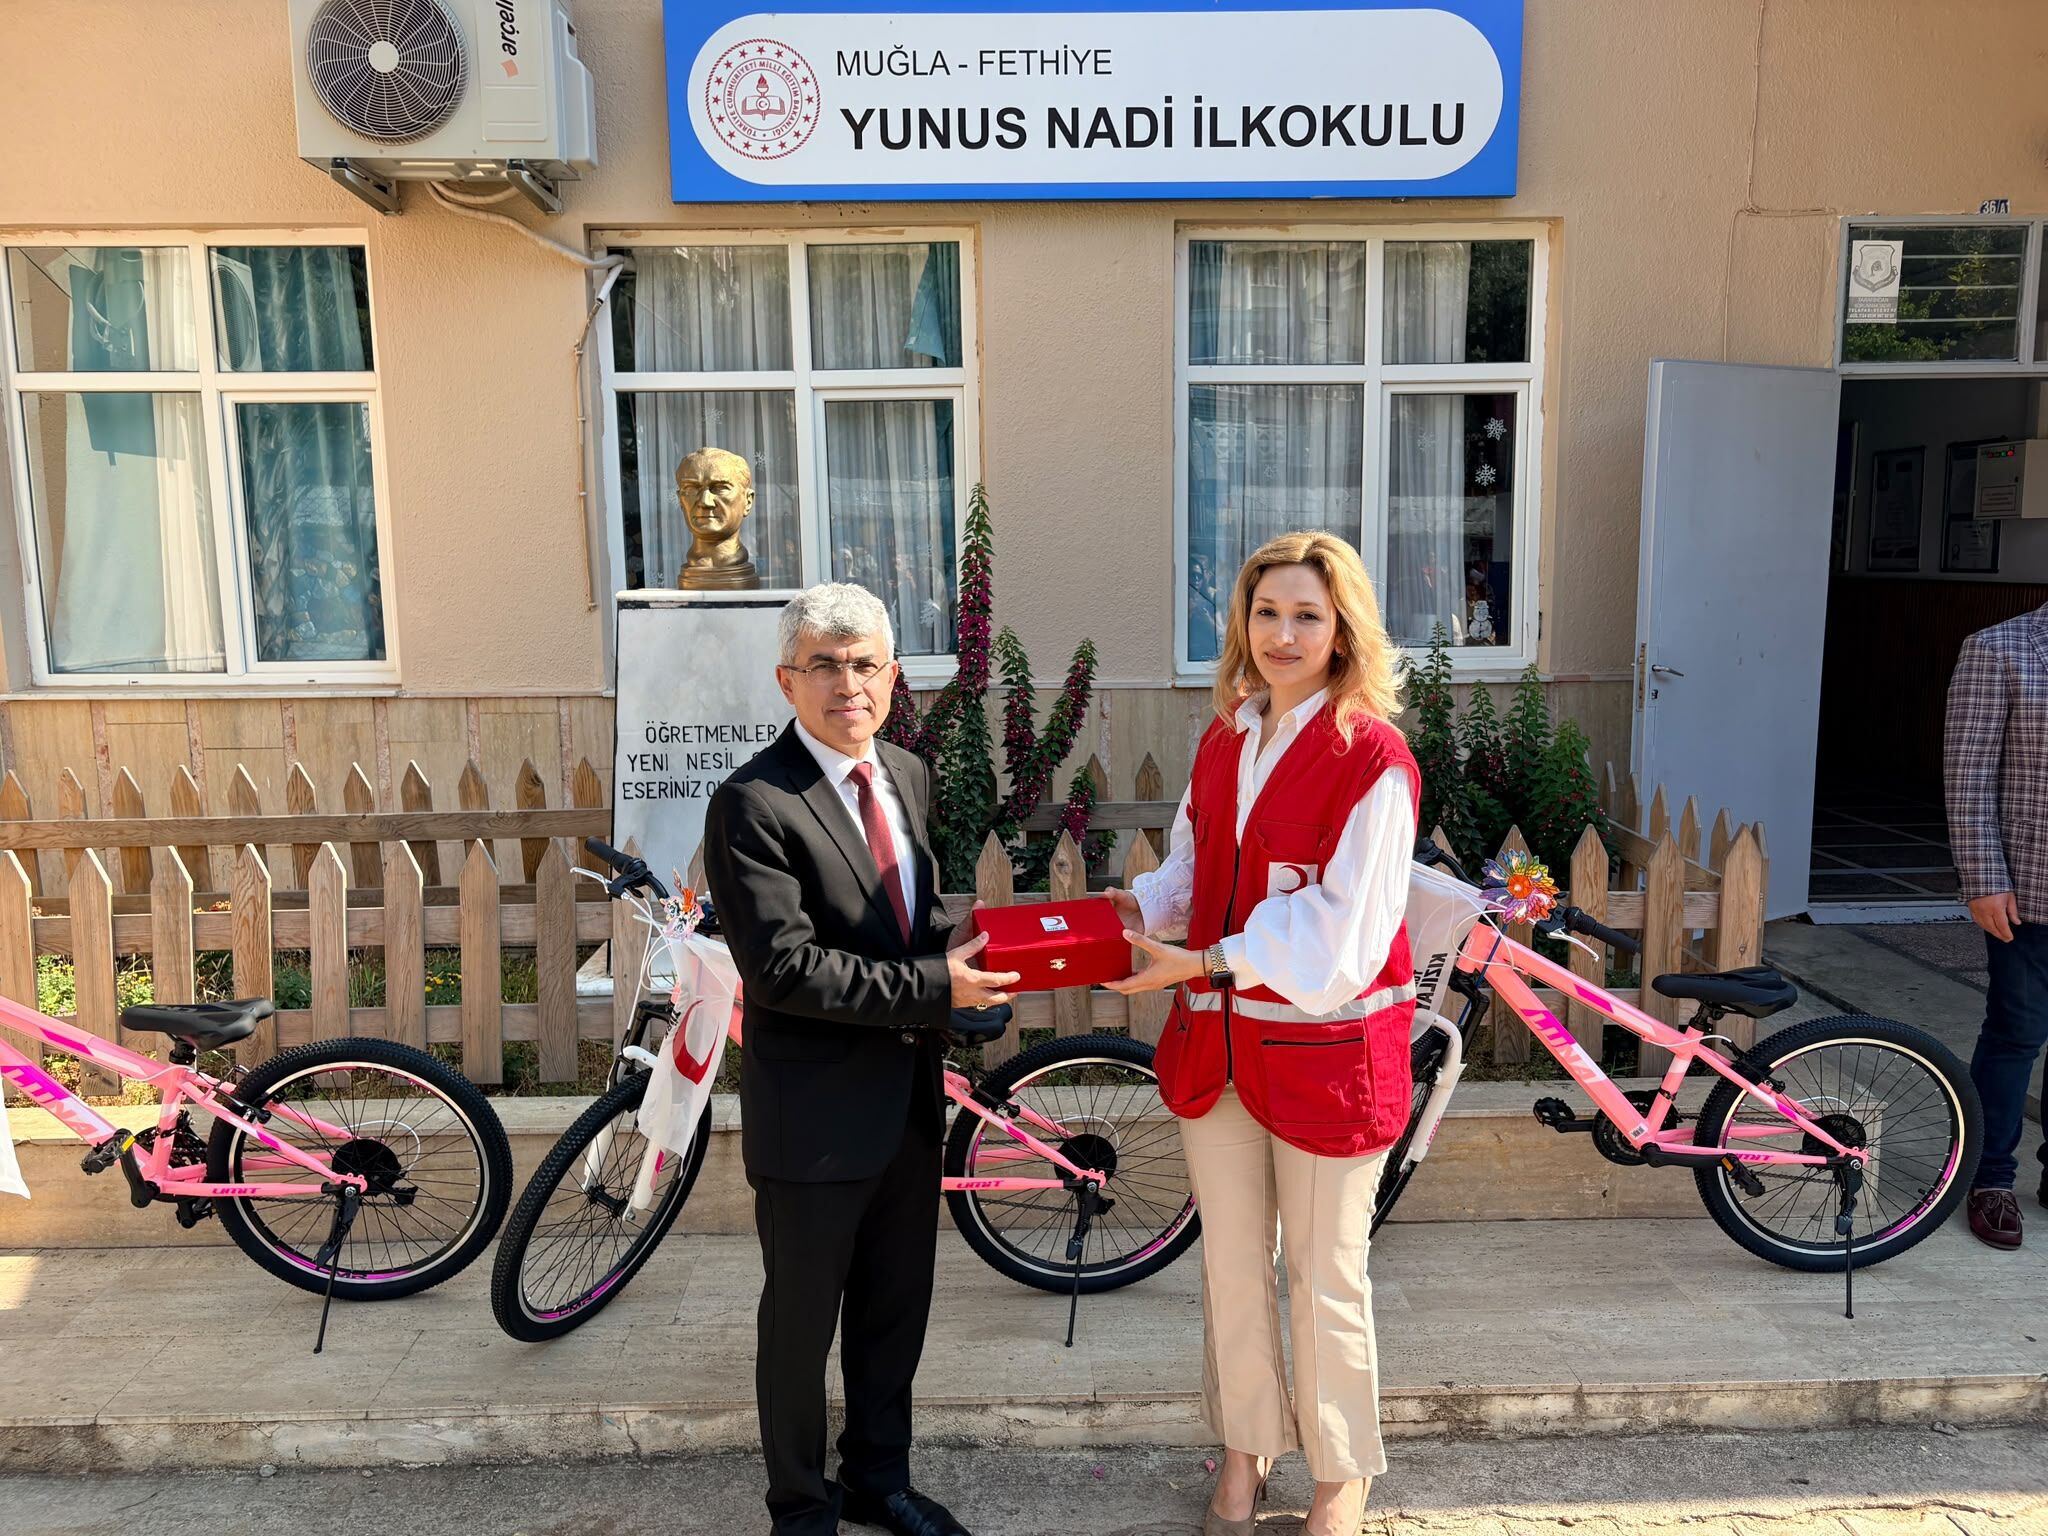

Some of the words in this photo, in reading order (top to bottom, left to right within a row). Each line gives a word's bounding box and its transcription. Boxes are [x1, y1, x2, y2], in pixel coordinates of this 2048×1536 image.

[496, 0, 520, 56] arçel
[759, 60, 781, 72] MİLLİ
[836, 44, 951, 76] MUĞLA
[979, 44, 1113, 76] FETHİYE
[839, 107, 1028, 150] YUNUS
[1047, 95, 1173, 149] NADİ
[1194, 95, 1465, 148] İLKOKULU
[645, 721, 777, 744] ÖĞRETMENLER
[686, 747, 739, 770] NESİL
[622, 775, 702, 800] ESERİNİZ
[1526, 1012, 1597, 1081] LUNA
